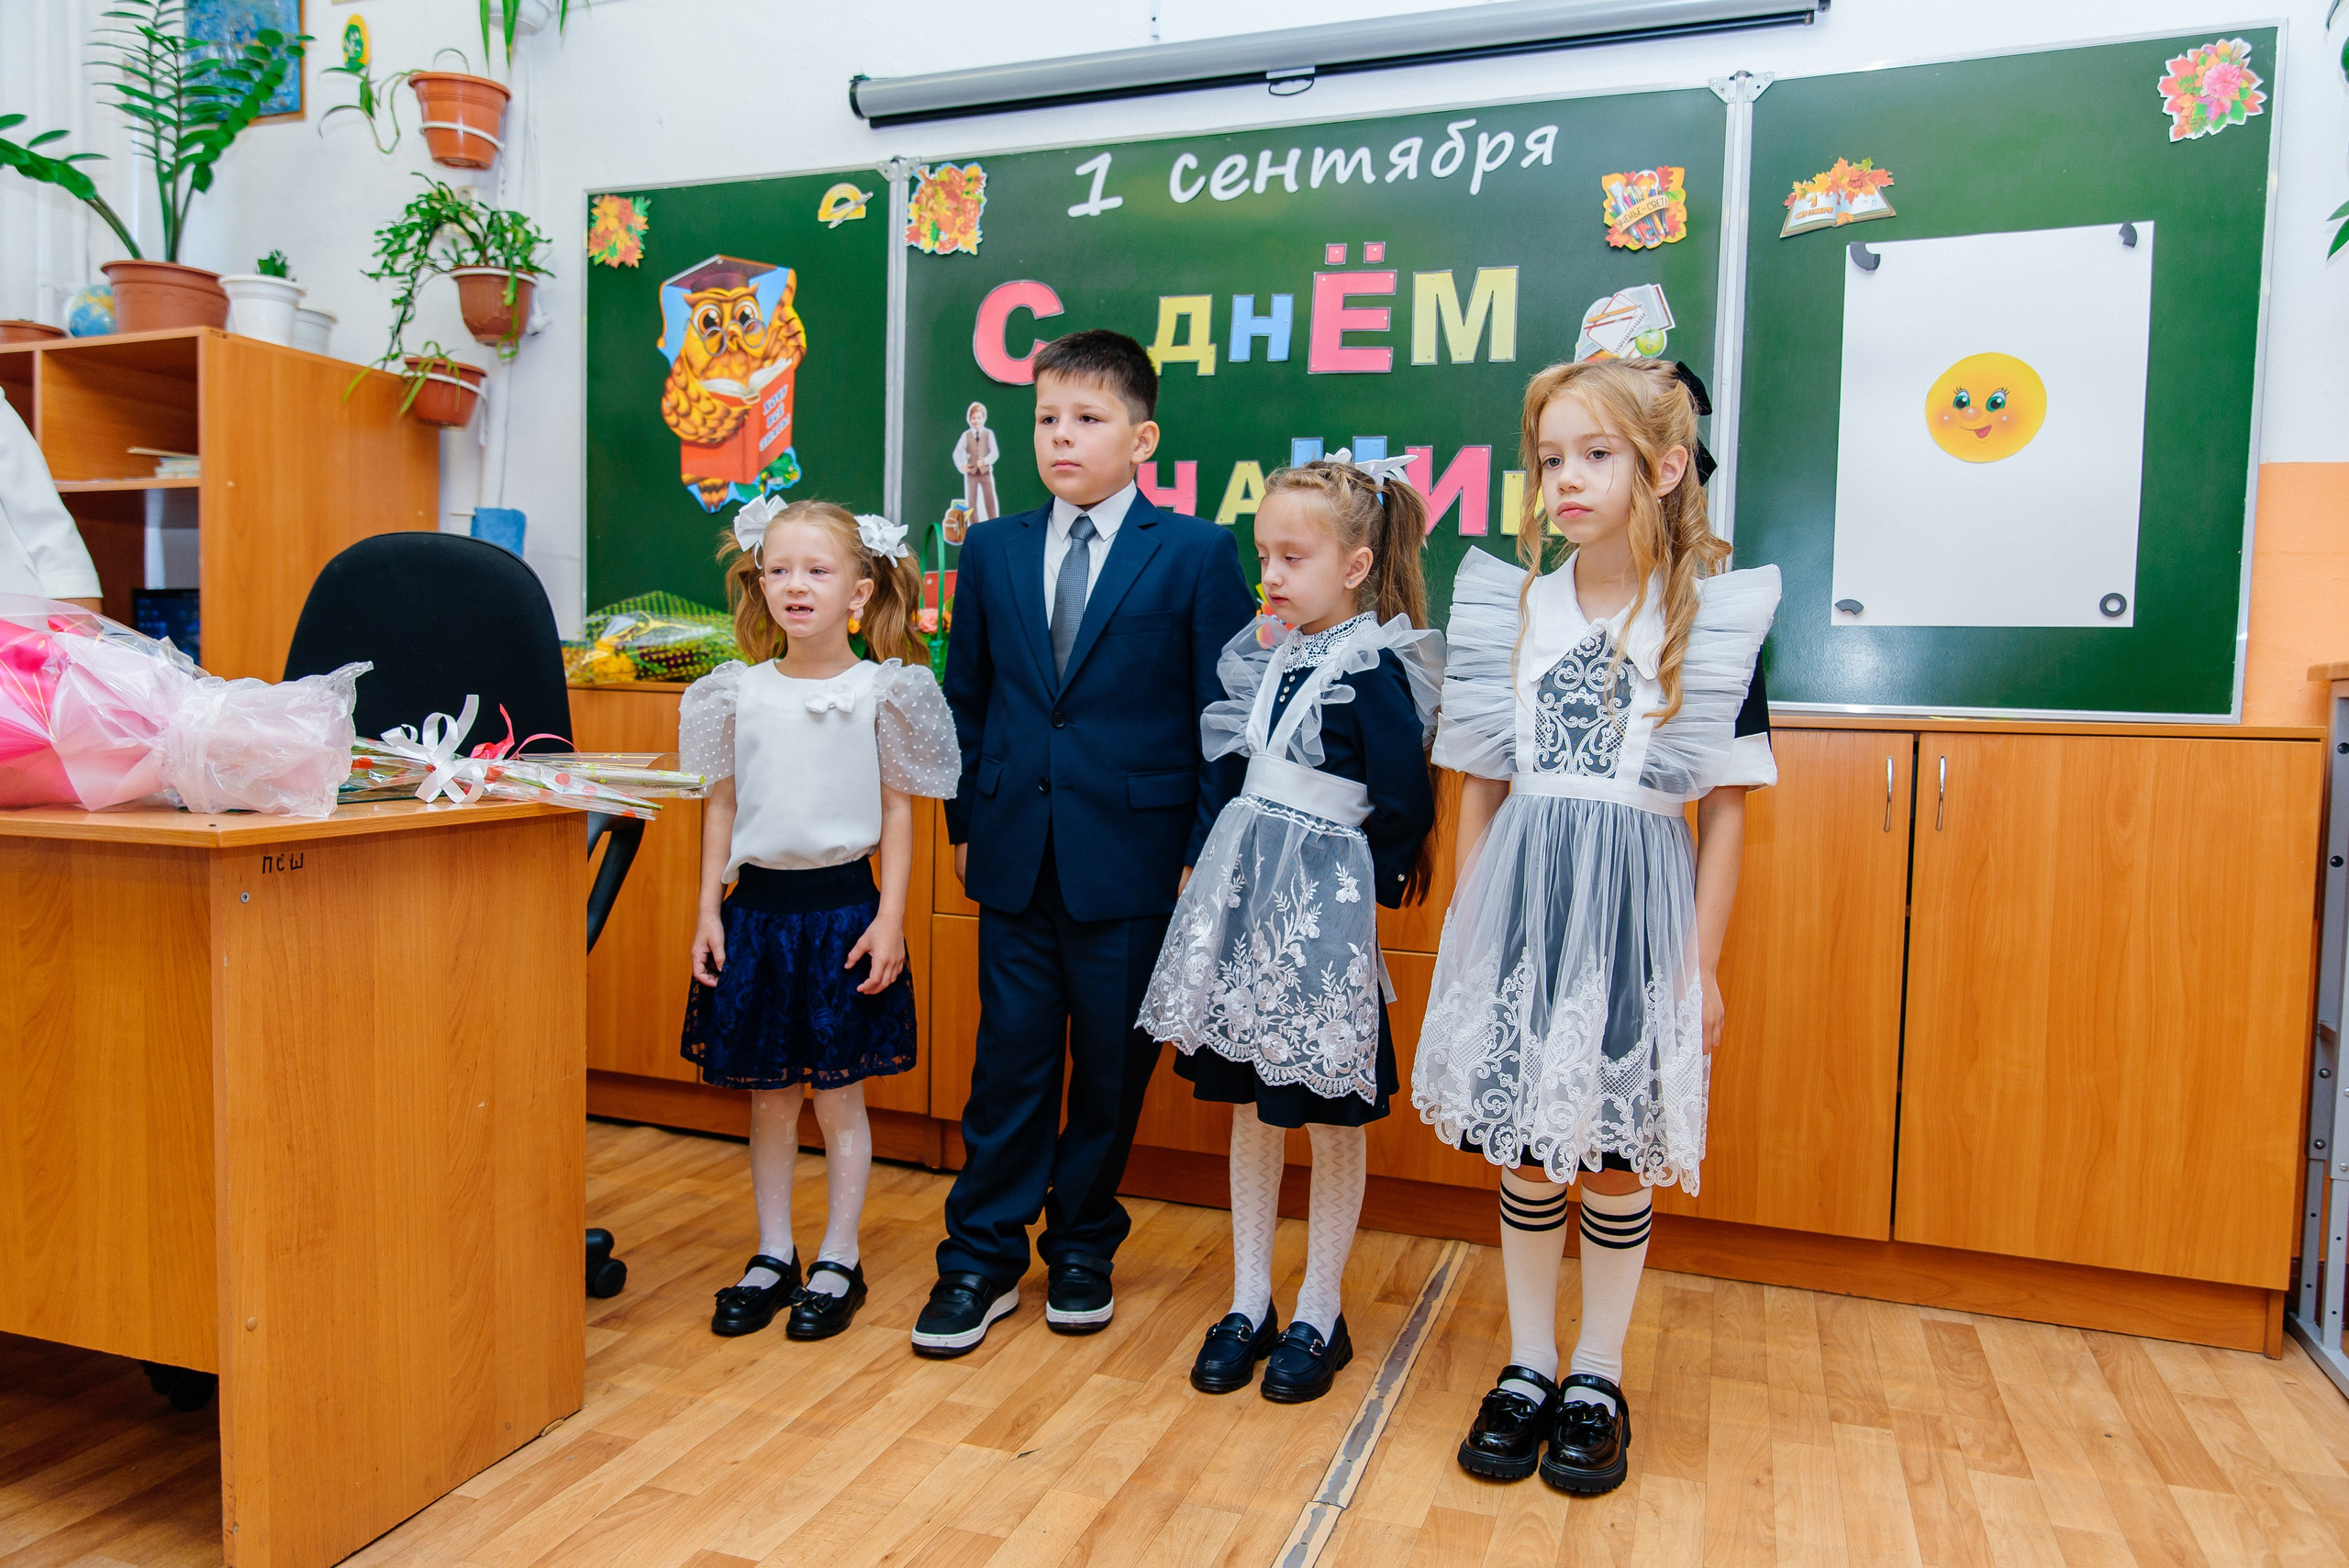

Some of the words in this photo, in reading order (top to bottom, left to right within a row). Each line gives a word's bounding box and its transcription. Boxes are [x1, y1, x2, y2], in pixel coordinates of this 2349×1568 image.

[1067, 152, 1123, 217] 1
[1169, 118, 1559, 204] сентября
[973, 280, 1064, 386] С
